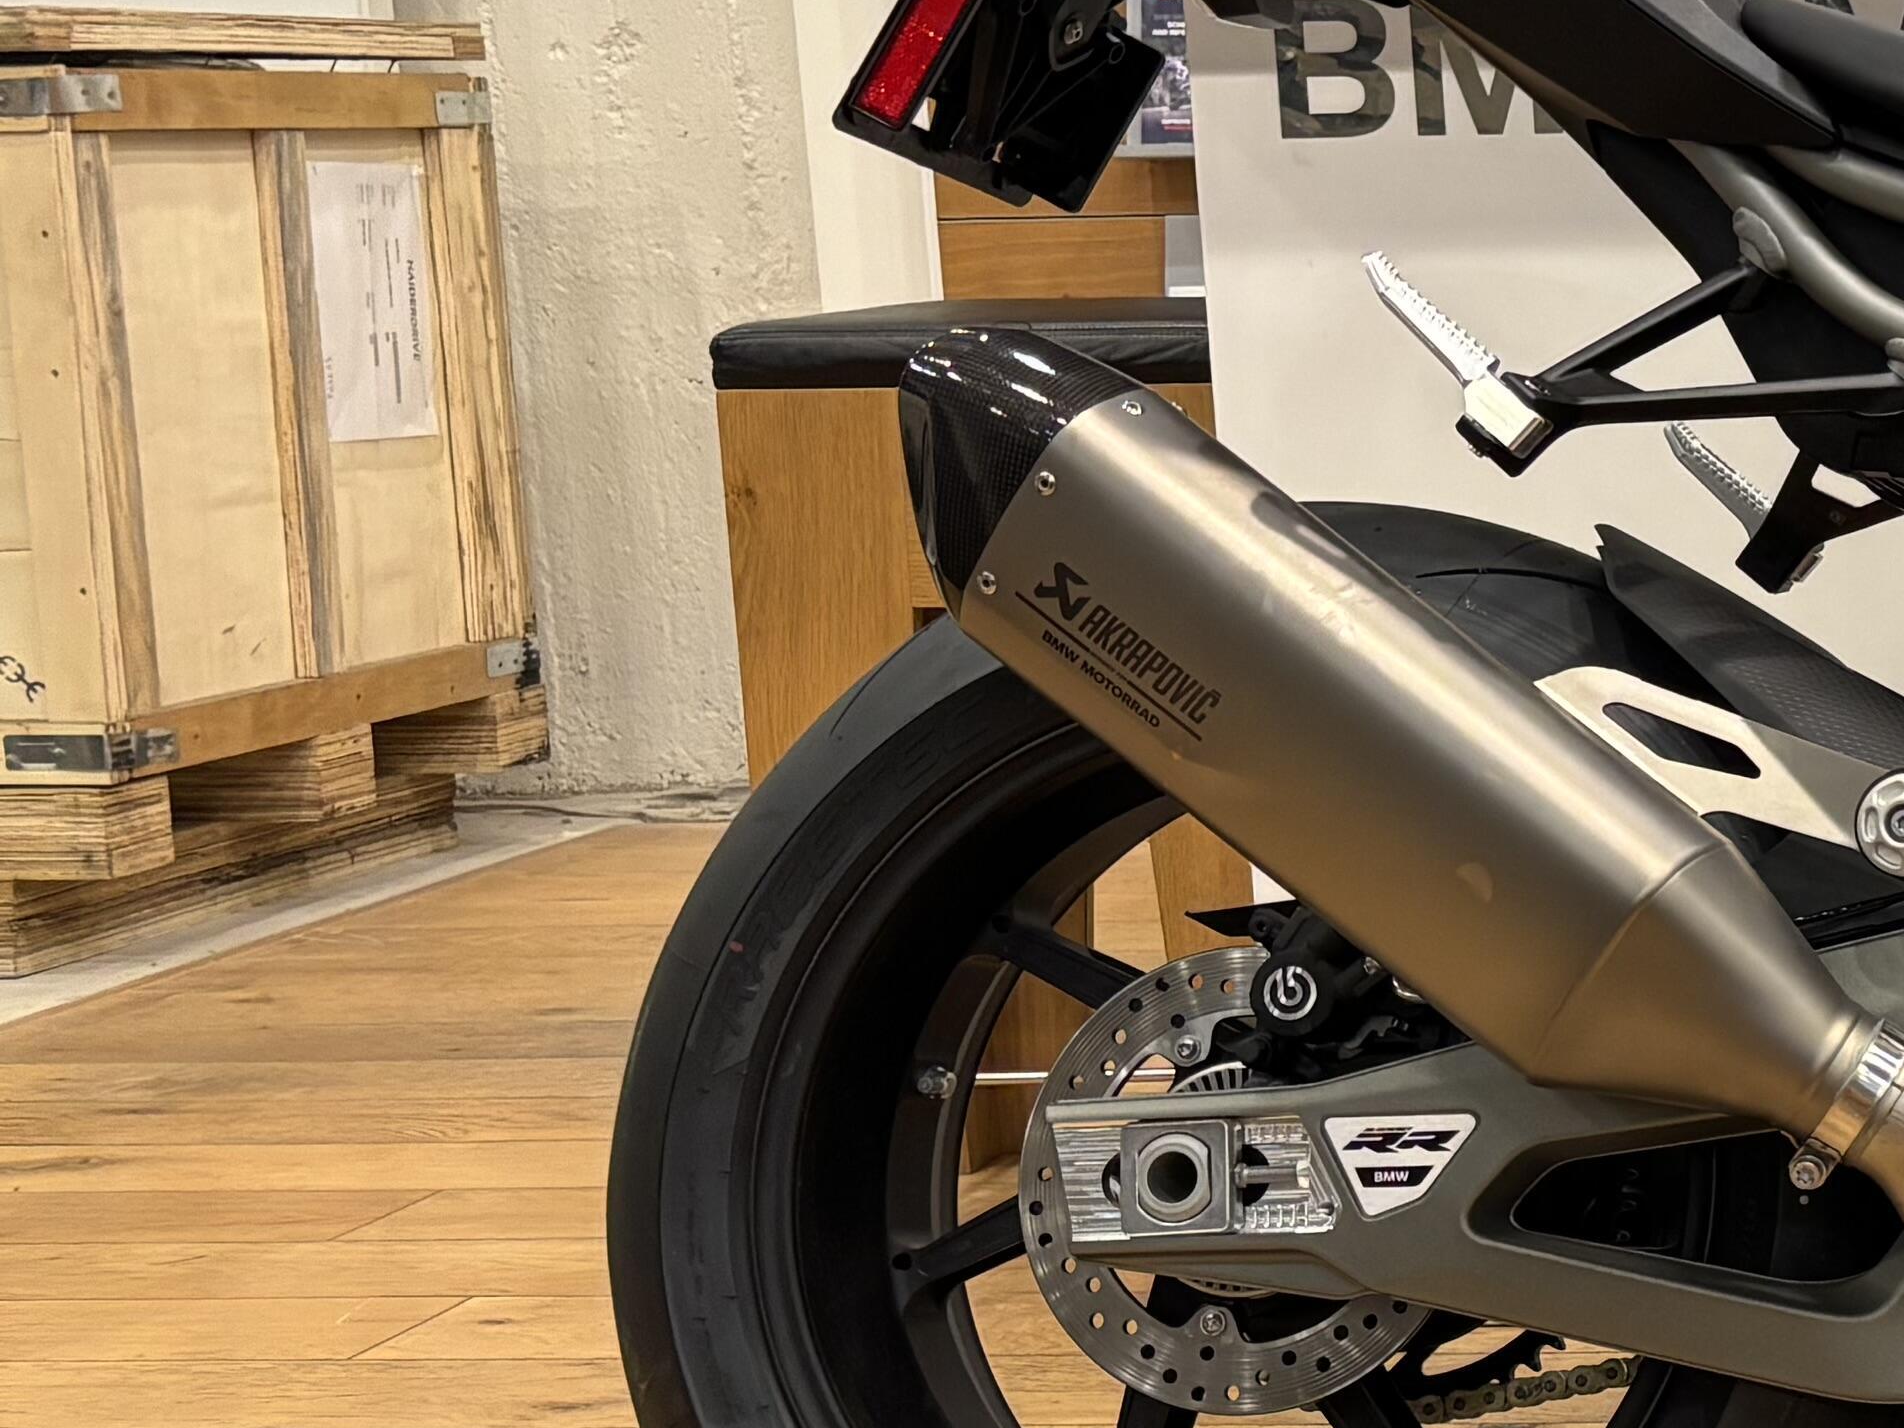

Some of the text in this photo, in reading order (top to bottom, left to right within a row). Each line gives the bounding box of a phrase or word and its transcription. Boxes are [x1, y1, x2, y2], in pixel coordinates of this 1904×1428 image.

[1041, 630, 1161, 729] BMW MOTORRAD
[1374, 1170, 1409, 1183] BMW
